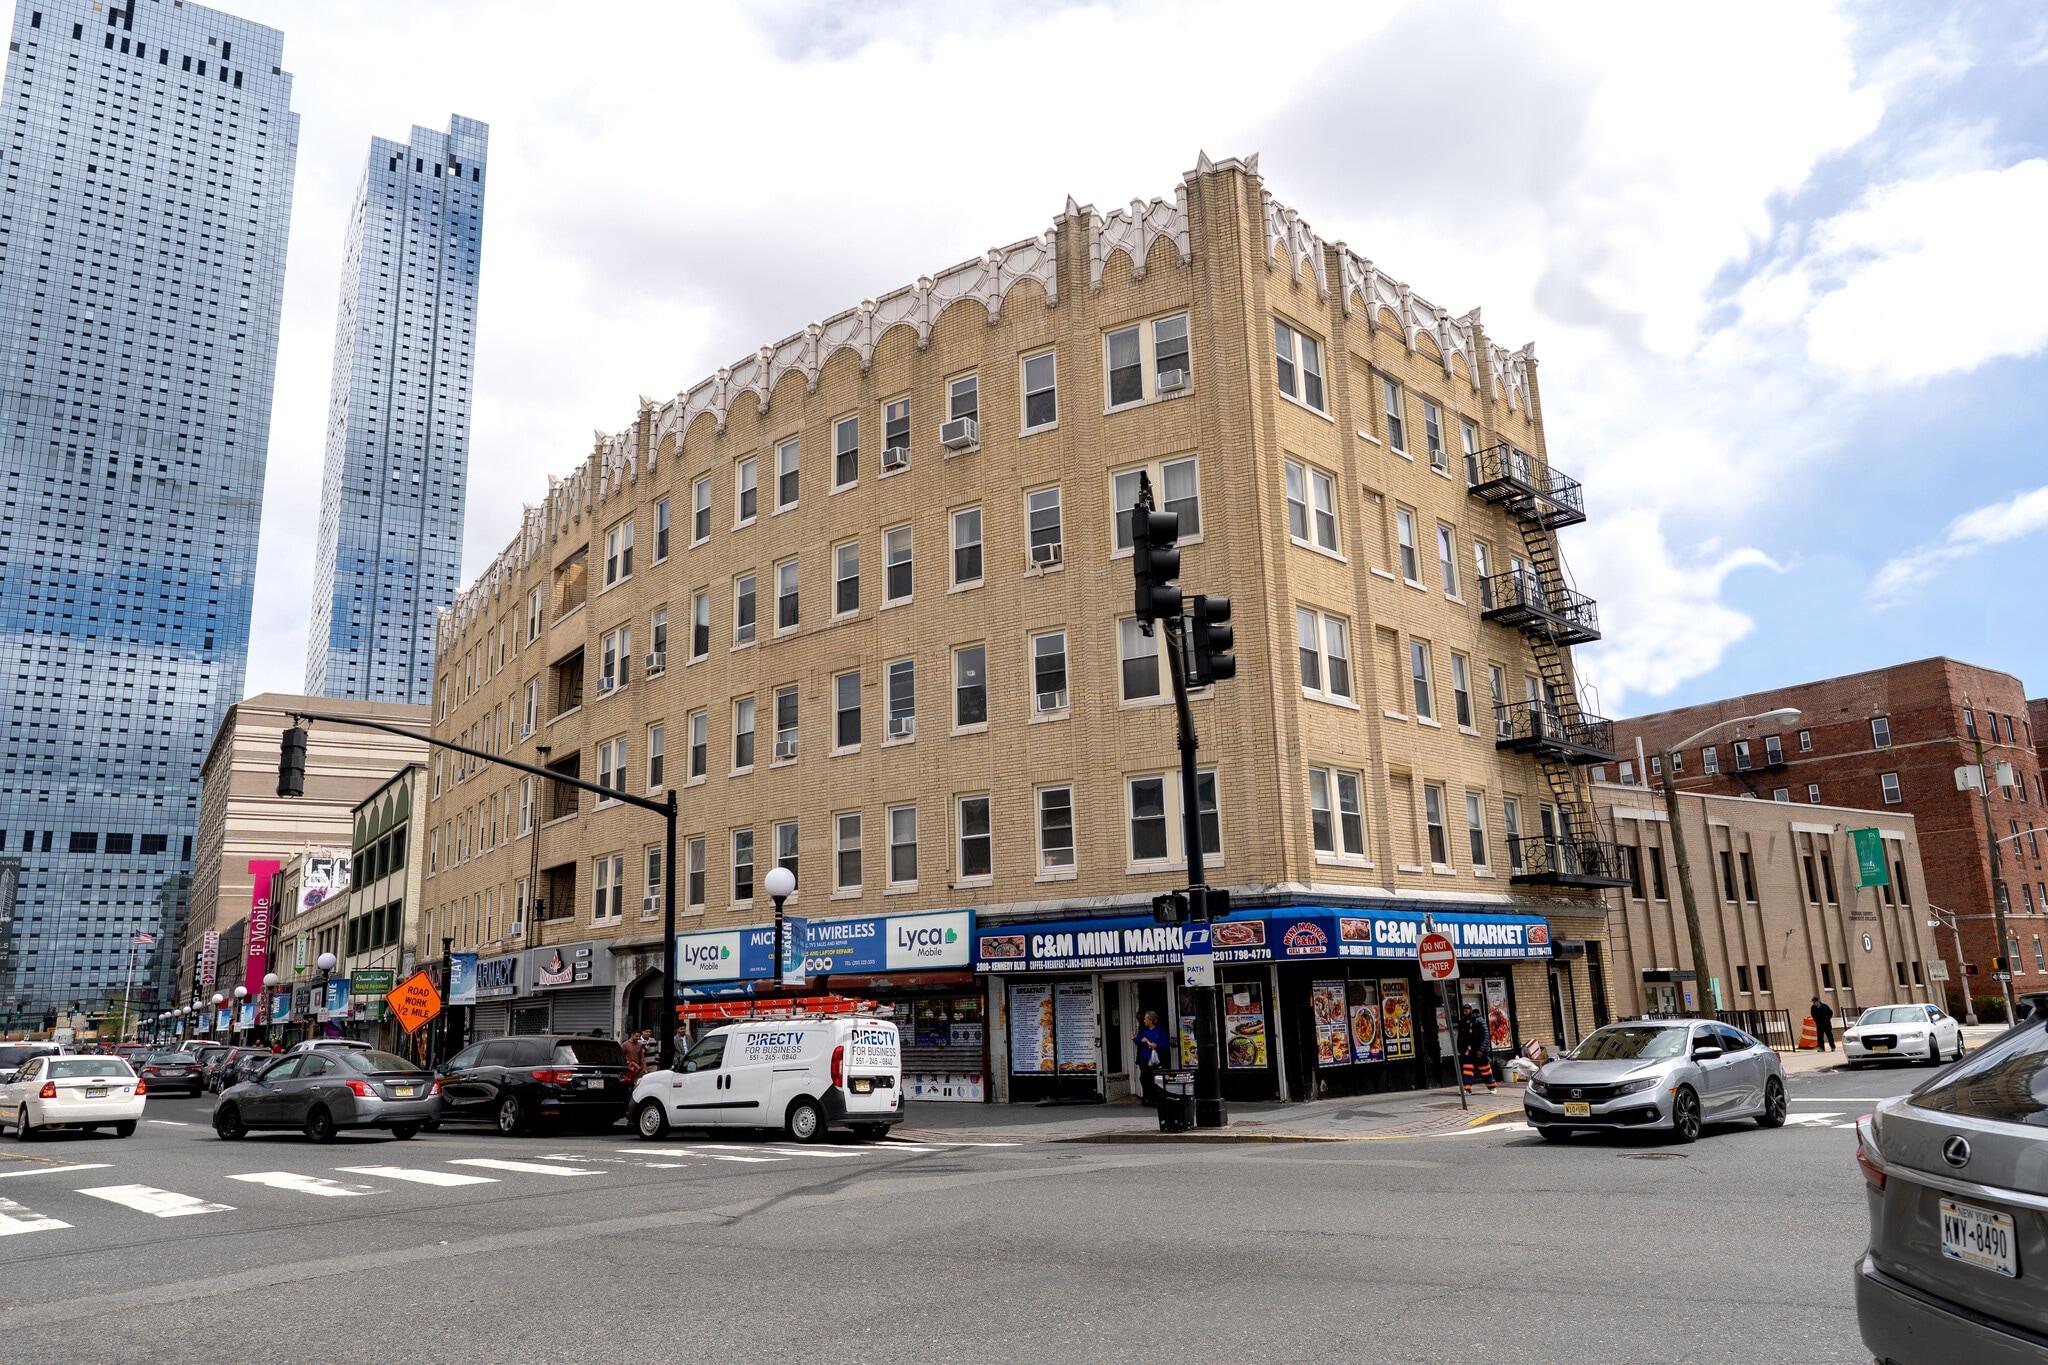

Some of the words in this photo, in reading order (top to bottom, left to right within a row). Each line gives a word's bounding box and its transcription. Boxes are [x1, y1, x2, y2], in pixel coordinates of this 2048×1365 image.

[251, 898, 269, 943] Mobile
[818, 923, 876, 940] WIRELESS
[898, 926, 942, 951] Lyca
[1284, 926, 1298, 945] MINI
[1298, 922, 1328, 943] MARKET
[1375, 920, 1417, 944] C&M
[1463, 924, 1523, 945] MARKET
[204, 932, 218, 958] DOLLAR
[783, 921, 792, 965] LEARN
[1032, 933, 1074, 958] C&M
[1078, 930, 1120, 956] MINI
[1124, 926, 1183, 953] MARK
[1295, 935, 1317, 946] C&M
[1423, 942, 1432, 951] DO
[1434, 941, 1447, 950] NOT
[1864, 937, 1871, 951] D
[685, 944, 719, 965] Lyca
[819, 949, 835, 957] LAPTOP
[917, 948, 942, 957] Mobile
[1234, 948, 1272, 960] 798-4770
[202, 960, 215, 984] DREAM
[451, 957, 462, 984] PLAY
[476, 958, 513, 988] ARMACY
[700, 962, 719, 971] Mobile
[991, 961, 1013, 971] KENNEDY
[1014, 961, 1026, 970] BLVD
[1428, 962, 1449, 971] ENTER
[328, 983, 338, 1001] LIVE
[407, 986, 430, 997] ROAD
[1383, 983, 1405, 991] CHICKEN
[191, 989, 200, 1017] LOK
[405, 996, 428, 1008] WORK
[397, 1003, 408, 1016] 1/2
[411, 1007, 430, 1019] MILE
[747, 1031, 804, 1046] DIRECTV
[851, 1029, 895, 1046] DIRECTV
[745, 1046, 761, 1054] FOR
[762, 1045, 802, 1054] BUSINESS
[852, 1046, 866, 1056] FOR
[867, 1046, 897, 1057] BUSINESS
[869, 1057, 878, 1065] 245
[882, 1058, 893, 1066] 0840
[1957, 1207, 1974, 1219] NEW
[1975, 1211, 1994, 1225] YORK
[1945, 1215, 1967, 1247] KWY
[1976, 1223, 2007, 1259] 8490
